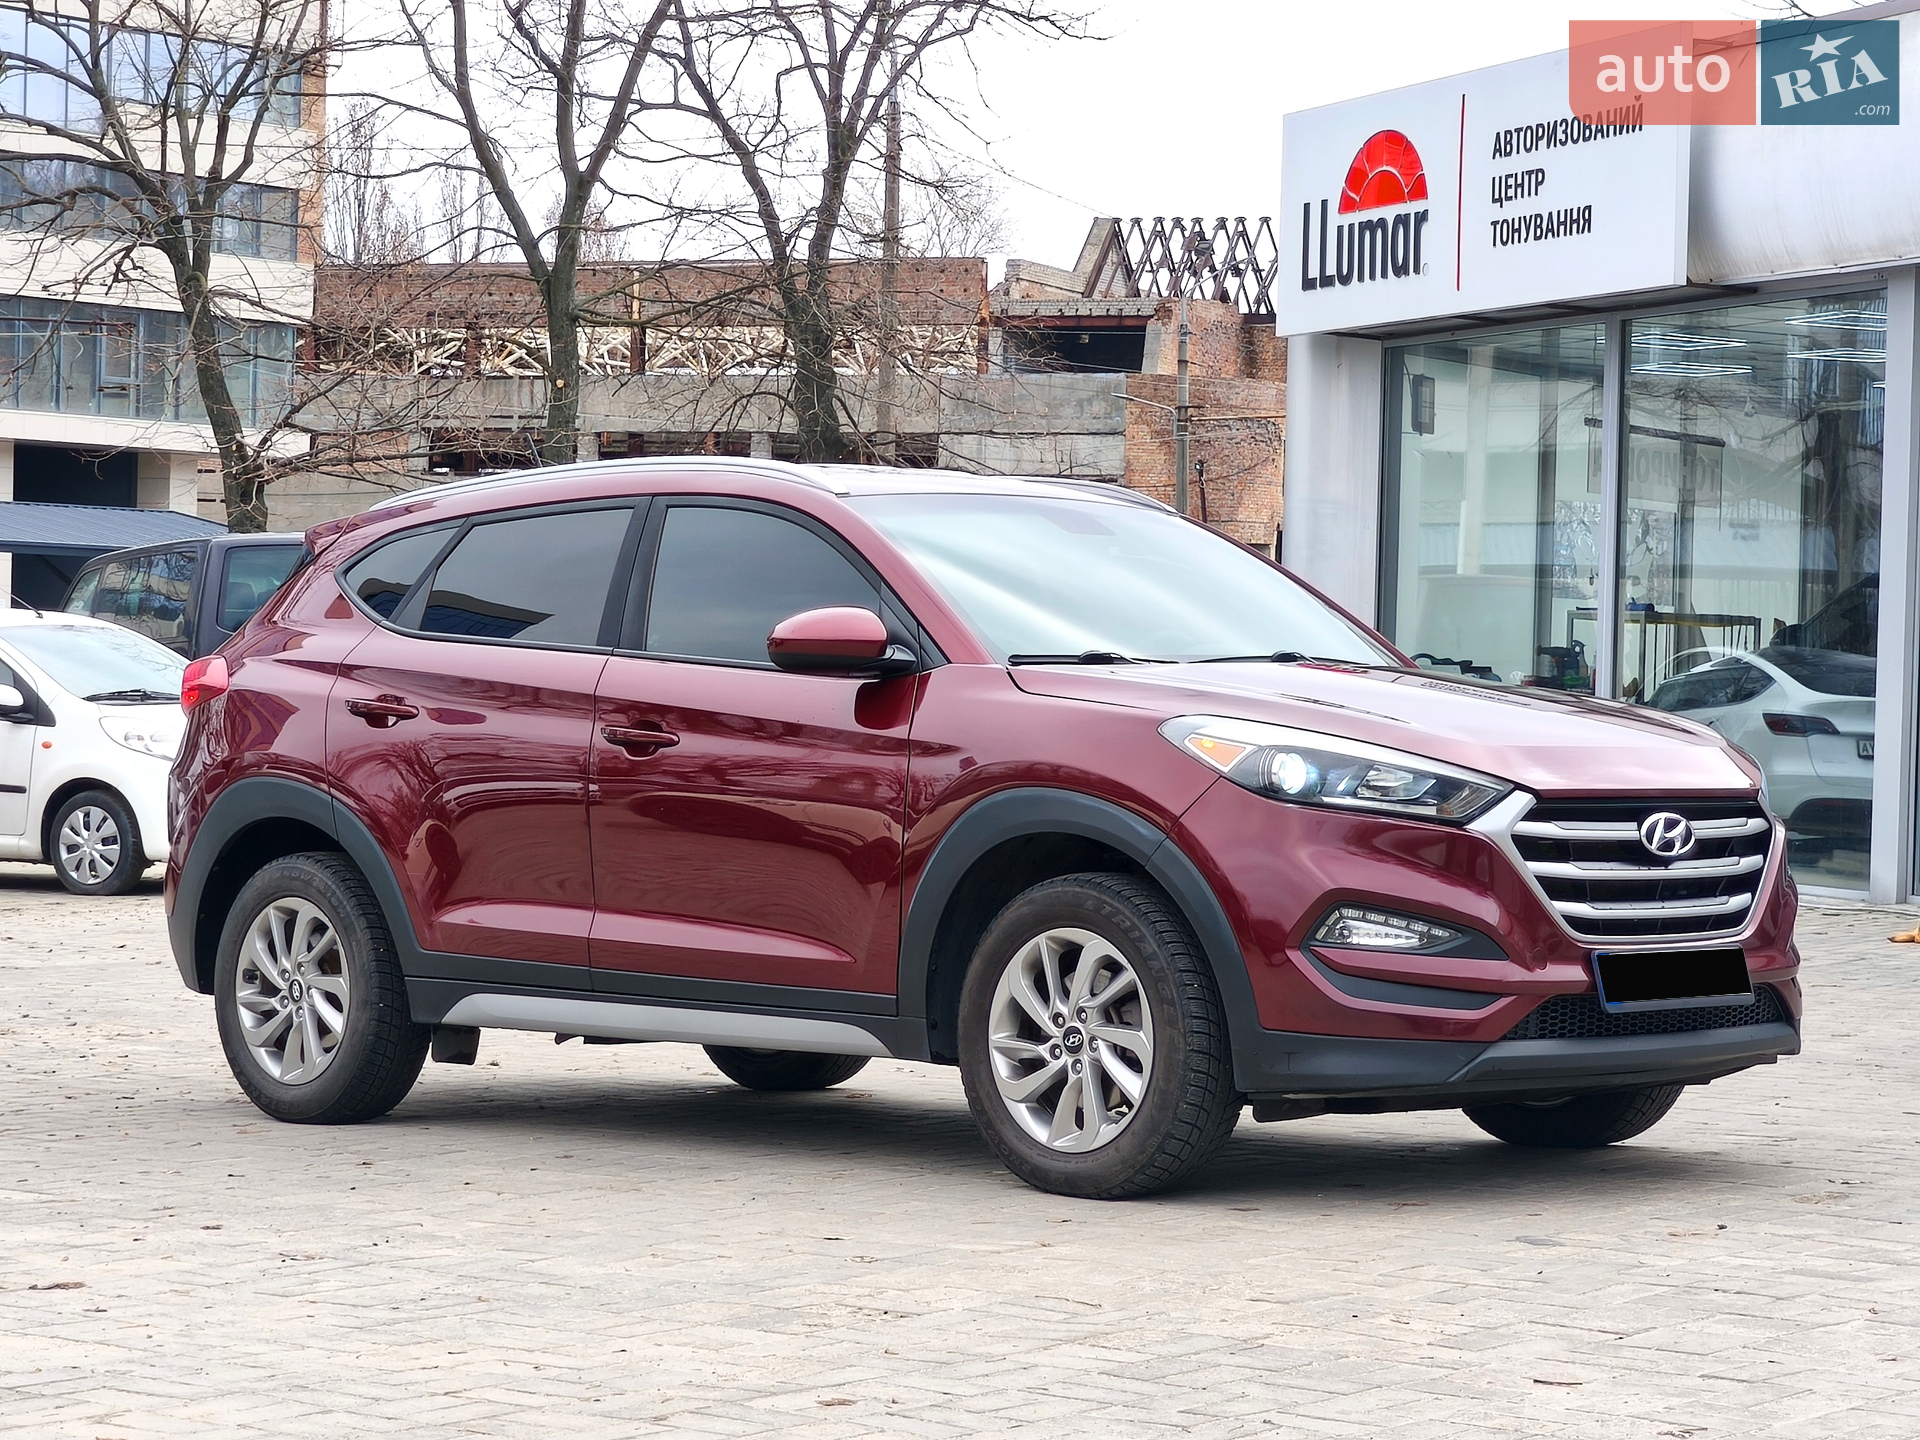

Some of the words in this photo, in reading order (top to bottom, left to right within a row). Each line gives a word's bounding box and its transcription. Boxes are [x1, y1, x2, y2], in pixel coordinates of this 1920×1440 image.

[1492, 95, 1645, 160] АВТОРИЗОВАНИЙ
[1491, 168, 1545, 209] ЦЕНТР
[1301, 199, 1429, 292] LLumar
[1490, 205, 1593, 248] ТОНУВАННЯ
